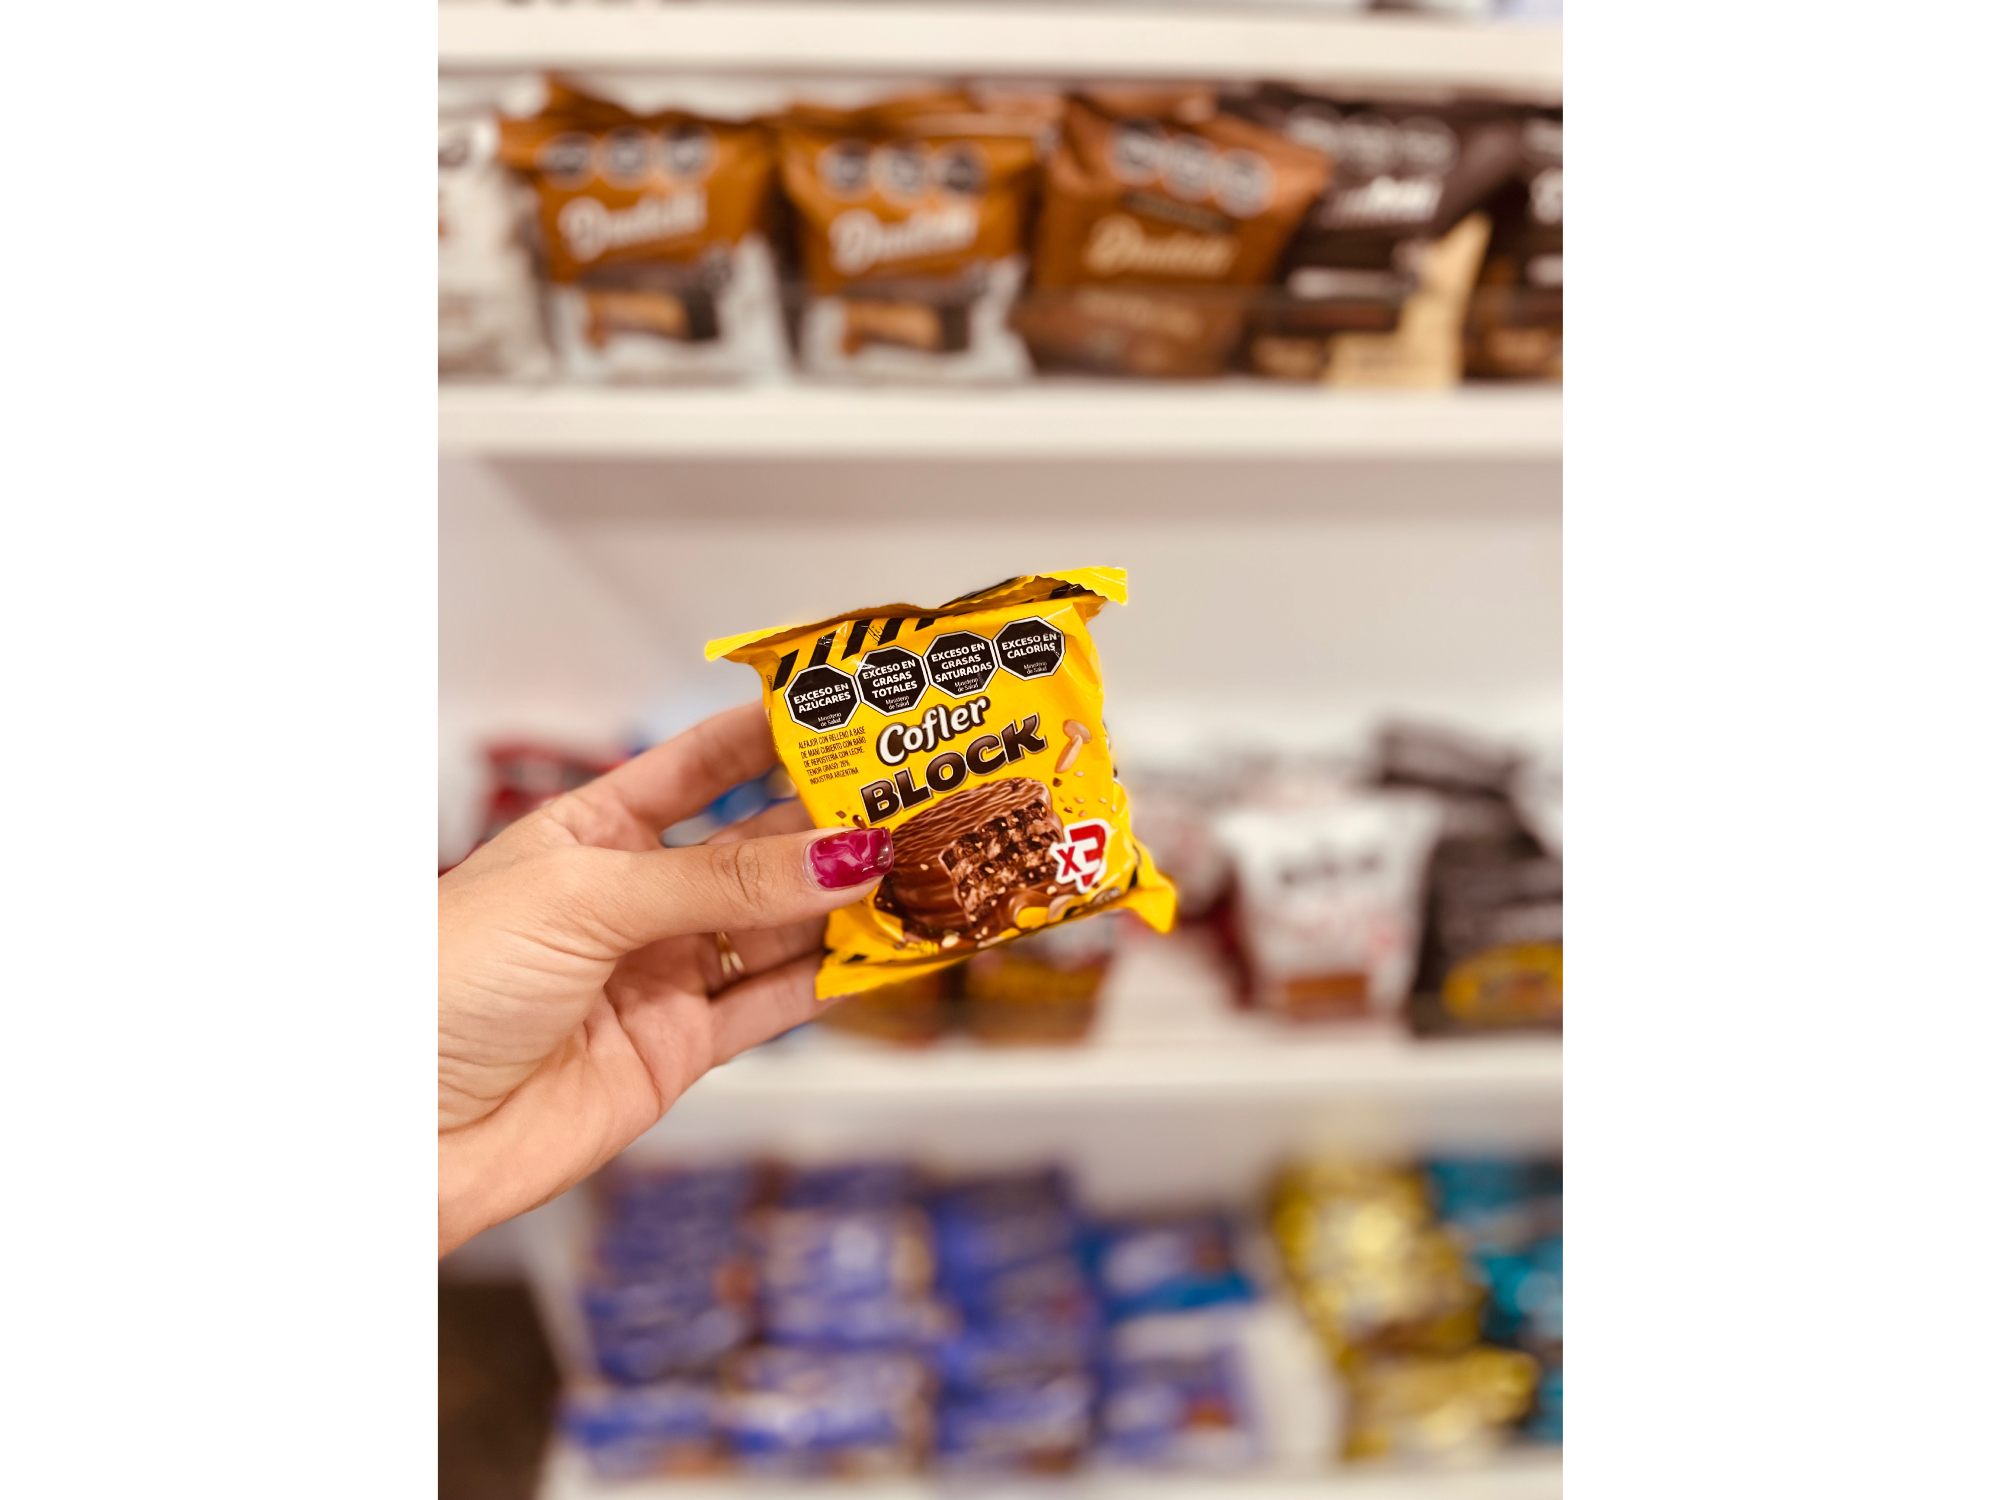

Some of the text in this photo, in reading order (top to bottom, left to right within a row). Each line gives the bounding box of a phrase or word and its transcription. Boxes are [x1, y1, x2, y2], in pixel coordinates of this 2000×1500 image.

[1002, 633, 1057, 650] EXCESO EN
[1007, 642, 1055, 658] CALORÍAS
[931, 643, 985, 662] EXCESO EN
[942, 654, 981, 669] GRASAS
[862, 659, 916, 679] EXCESO EN
[935, 662, 992, 682] SATURADAS
[873, 671, 912, 687] GRASAS
[955, 678, 978, 687] Ministerio
[793, 683, 849, 704] EXCESO EN
[872, 680, 917, 698] TOTALES
[799, 692, 851, 713] AZÚCARES
[886, 696, 909, 705] Ministerio
[896, 700, 909, 708] Salud
[818, 712, 842, 722] Ministerio
[798, 738, 818, 749] ALFAJOR
[819, 736, 828, 744] CON
[829, 731, 849, 742] RELLENO
[853, 726, 866, 736] BASE
[877, 696, 990, 765] Cofler
[801, 751, 807, 759] DE
[820, 743, 842, 754] CUBIERTO
[843, 740, 853, 748] CON
[853, 736, 866, 745] BAÑO
[804, 760, 811, 768] DE
[839, 751, 848, 759] CON
[859, 712, 1049, 825] BLOCK
[806, 767, 822, 776] TENOR
[810, 767, 859, 785] INDUSTRIA ARGENTINA
